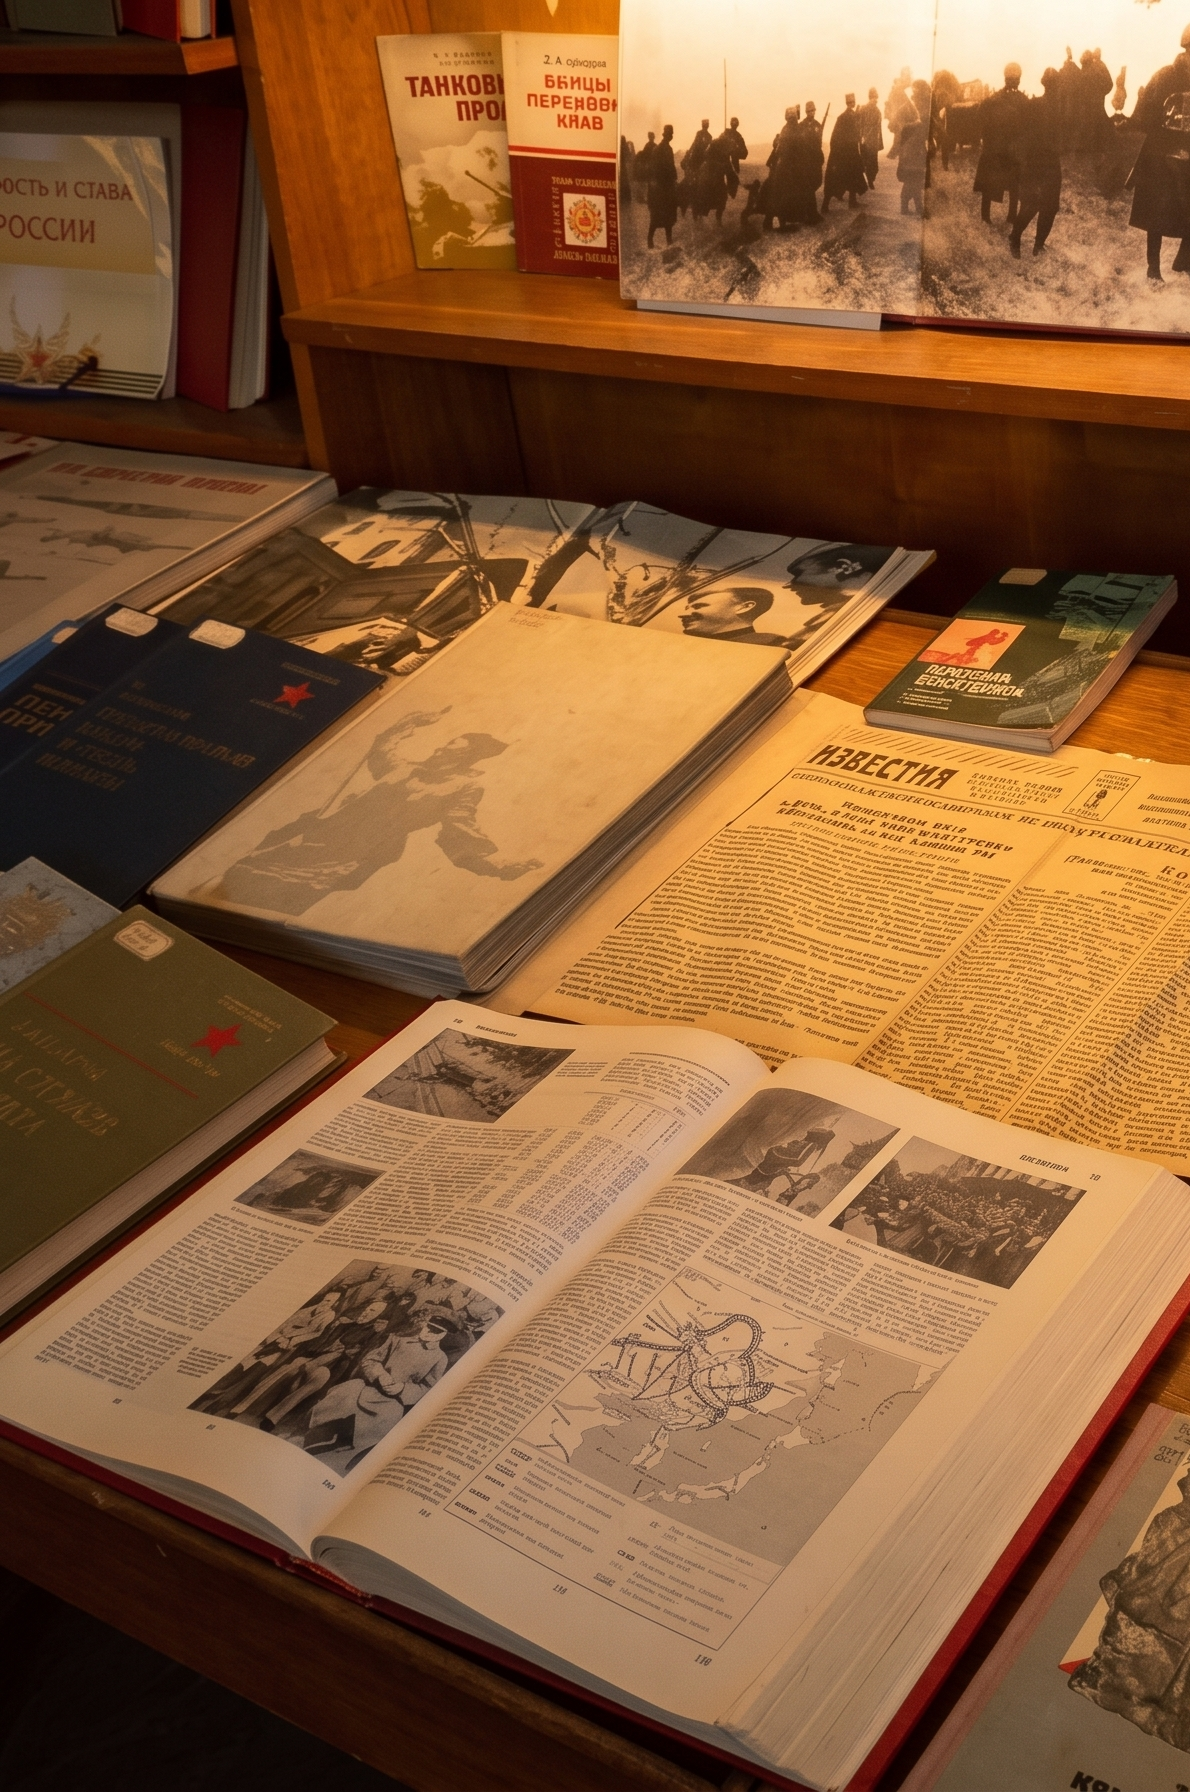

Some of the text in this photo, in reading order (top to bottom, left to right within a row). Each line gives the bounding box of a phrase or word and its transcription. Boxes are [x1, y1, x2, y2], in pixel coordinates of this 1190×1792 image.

[0, 177, 49, 197] ОСТЬ
[56, 181, 67, 198] И
[806, 744, 960, 790] ИЗВЕСТИЯ
